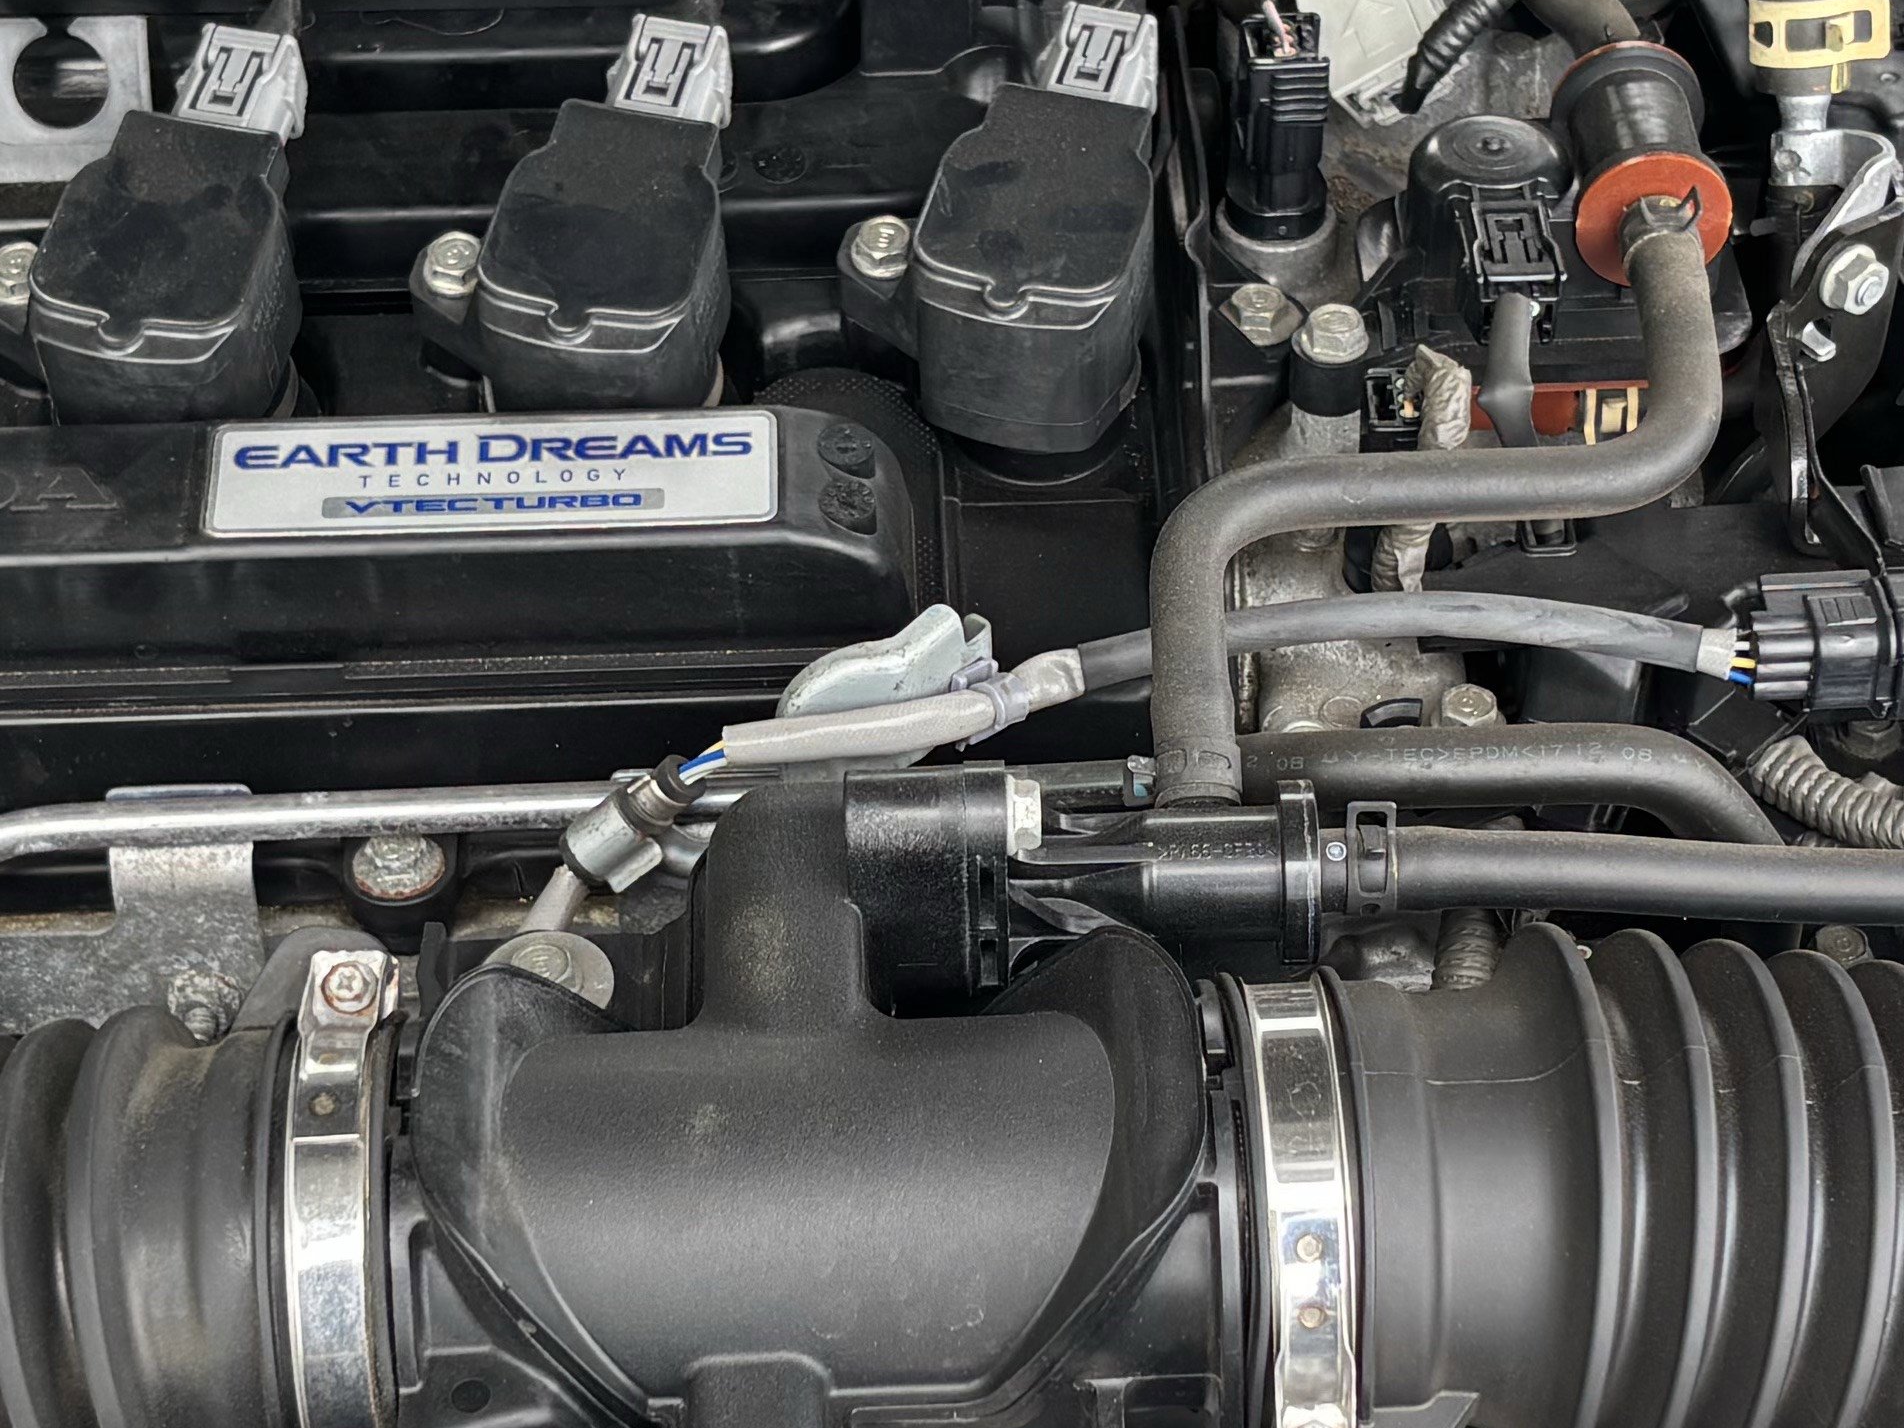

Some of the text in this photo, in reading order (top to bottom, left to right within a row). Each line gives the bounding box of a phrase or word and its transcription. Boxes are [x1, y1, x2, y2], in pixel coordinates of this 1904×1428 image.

[233, 431, 754, 470] EARTH DREAMS
[358, 468, 630, 489] TECHNOLOGY
[481, 491, 643, 512] TURBO
